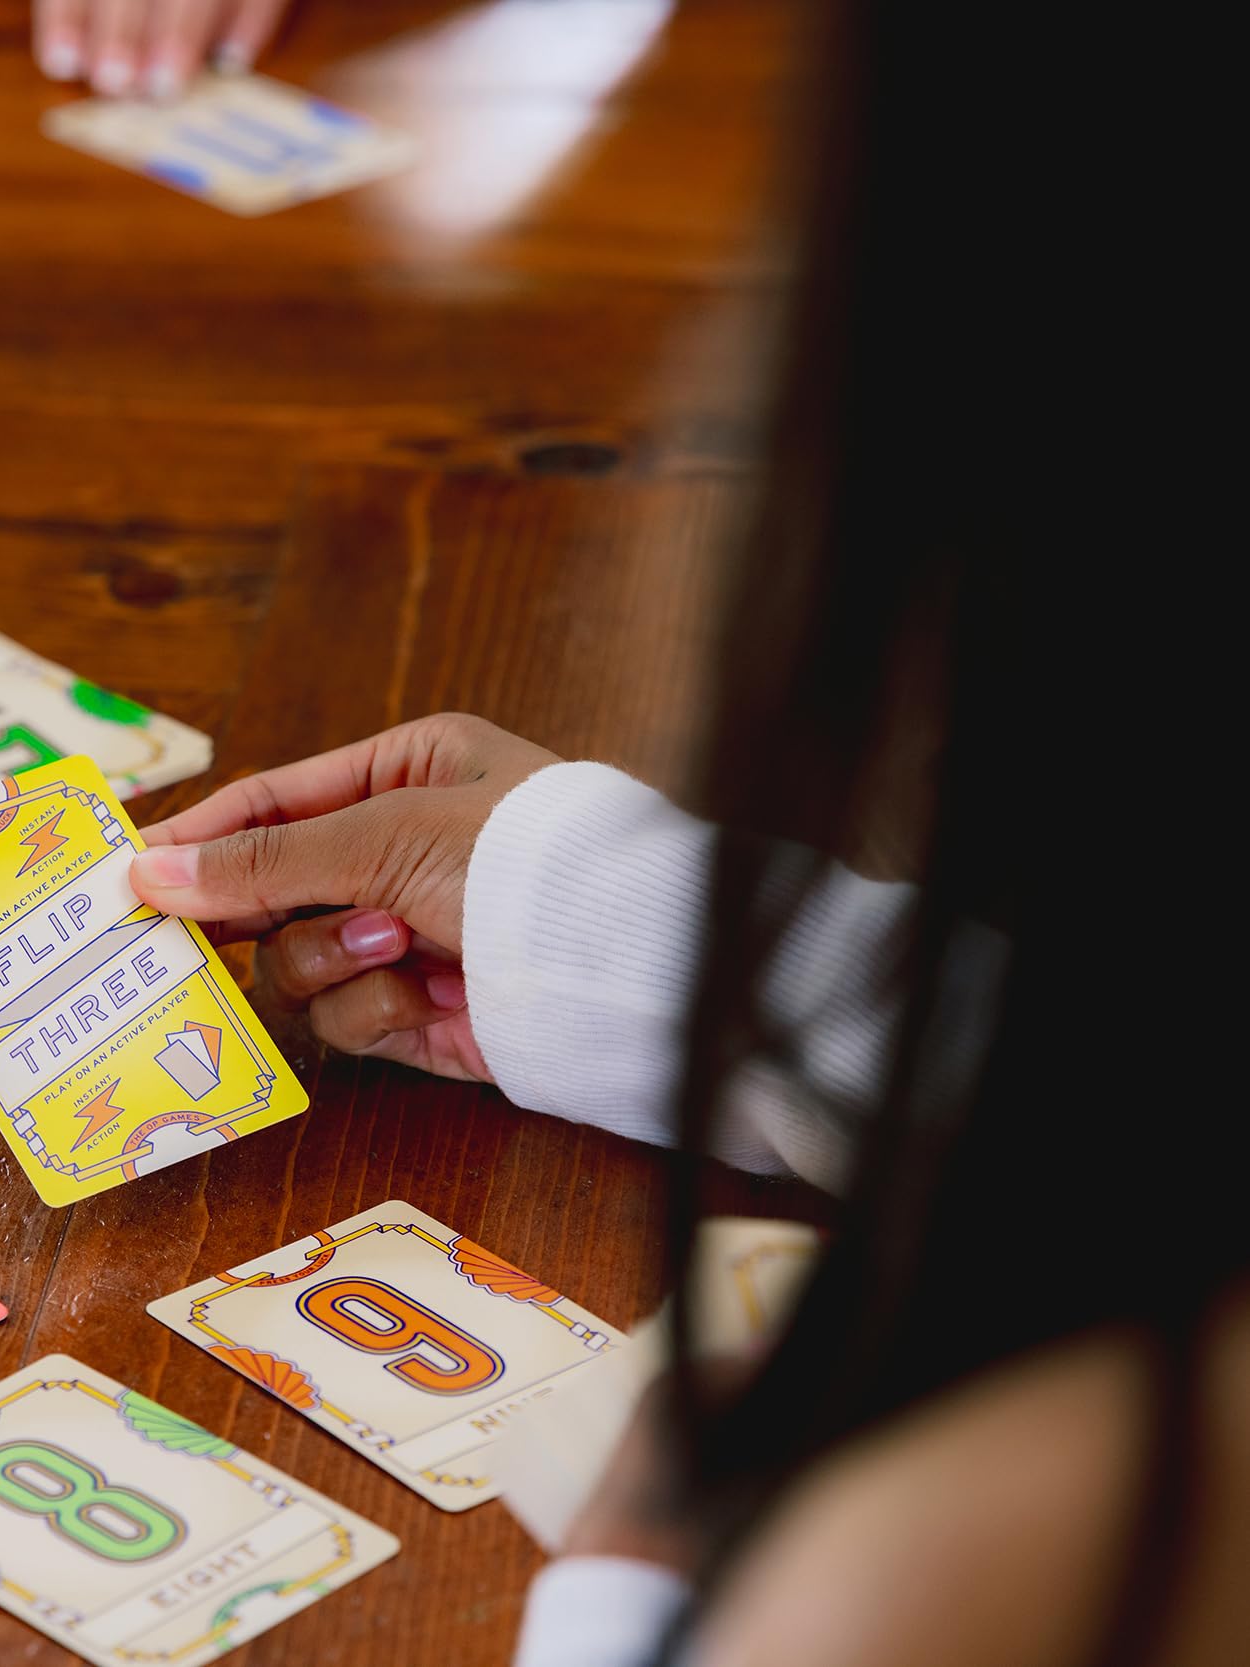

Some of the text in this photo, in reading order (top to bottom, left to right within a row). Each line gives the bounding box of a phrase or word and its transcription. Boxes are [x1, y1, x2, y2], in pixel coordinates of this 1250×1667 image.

[19, 805, 57, 837] INSTANT
[31, 850, 65, 877] ACTION
[13, 882, 50, 912] ACTIVE
[50, 851, 93, 884] PLAYER
[9, 946, 169, 1074] THREE
[44, 989, 190, 1104] PLAY ON AN ACTIVE PLAYER
[73, 1073, 112, 1108] INSTANT
[86, 1122, 121, 1152] ACTION
[130, 1131, 146, 1146] THE
[162, 1113, 200, 1123] GAMES
[259, 1253, 329, 1285] PRESS YOUR LUCK
[295, 1276, 505, 1397] 9
[150, 1540, 257, 1610] EIGHT
